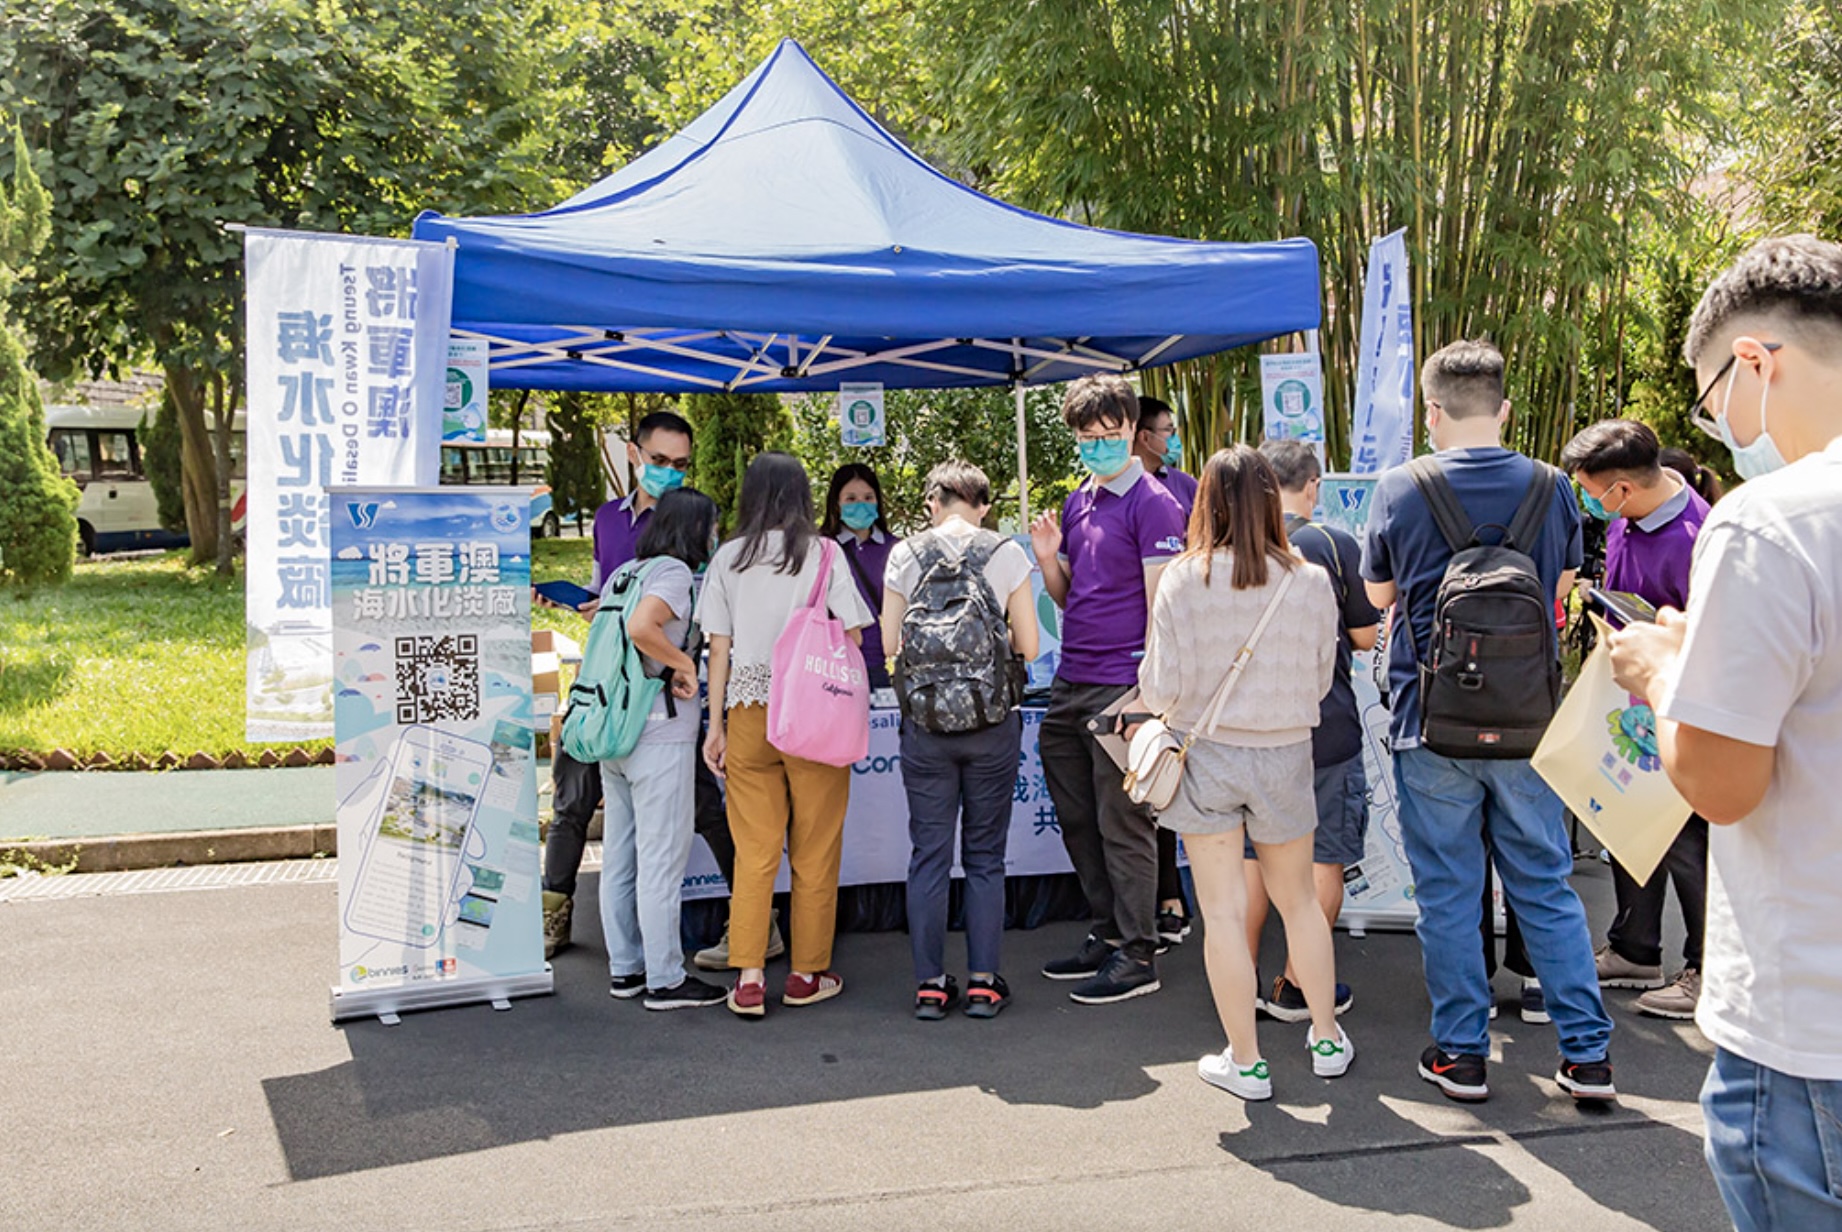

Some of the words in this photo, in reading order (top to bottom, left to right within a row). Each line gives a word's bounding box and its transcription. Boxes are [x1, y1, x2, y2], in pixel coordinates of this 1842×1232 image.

[368, 541, 500, 586] 將軍澳
[352, 585, 518, 620] 海水化淡廠
